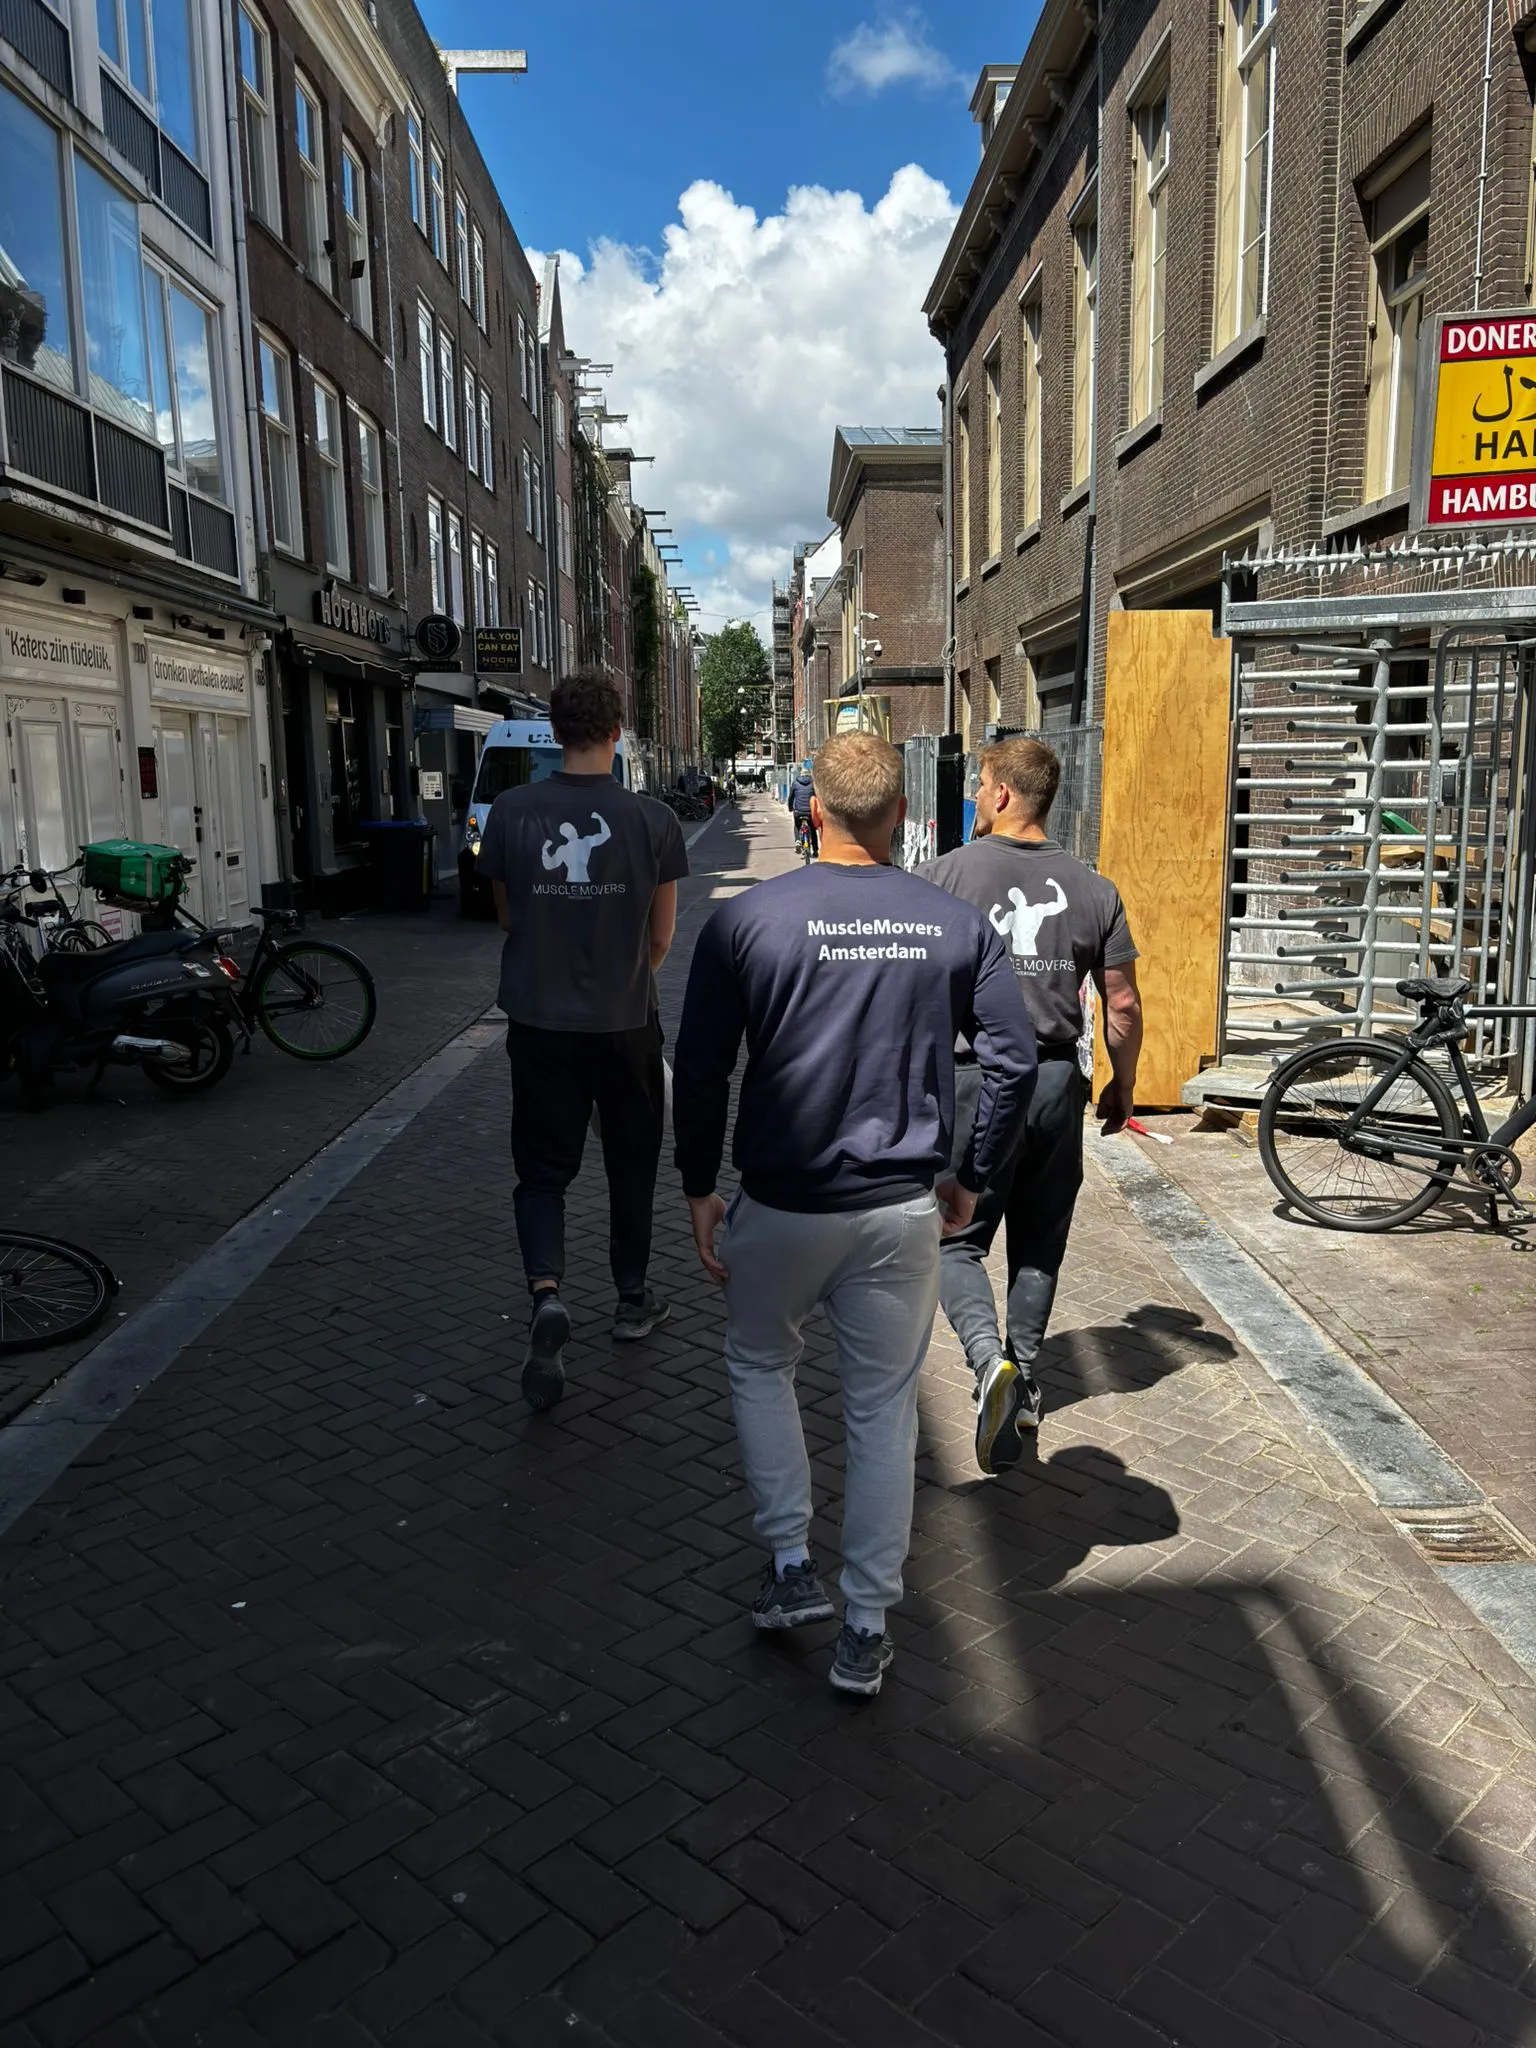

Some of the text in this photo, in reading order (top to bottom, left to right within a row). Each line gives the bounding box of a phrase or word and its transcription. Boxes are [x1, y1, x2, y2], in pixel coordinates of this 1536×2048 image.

[1475, 428, 1536, 461] HA
[320, 580, 391, 643] HOTSHOTS
[477, 632, 519, 640] ALL YOU
[477, 643, 519, 651] CAN EAT
[482, 656, 517, 664] NOORI
[154, 656, 187, 683] dronken
[187, 664, 220, 689] verhalen
[532, 883, 627, 896] MUSCLE MOVERS
[807, 919, 943, 937] MuscleMovers
[818, 942, 927, 961] Amsterdam
